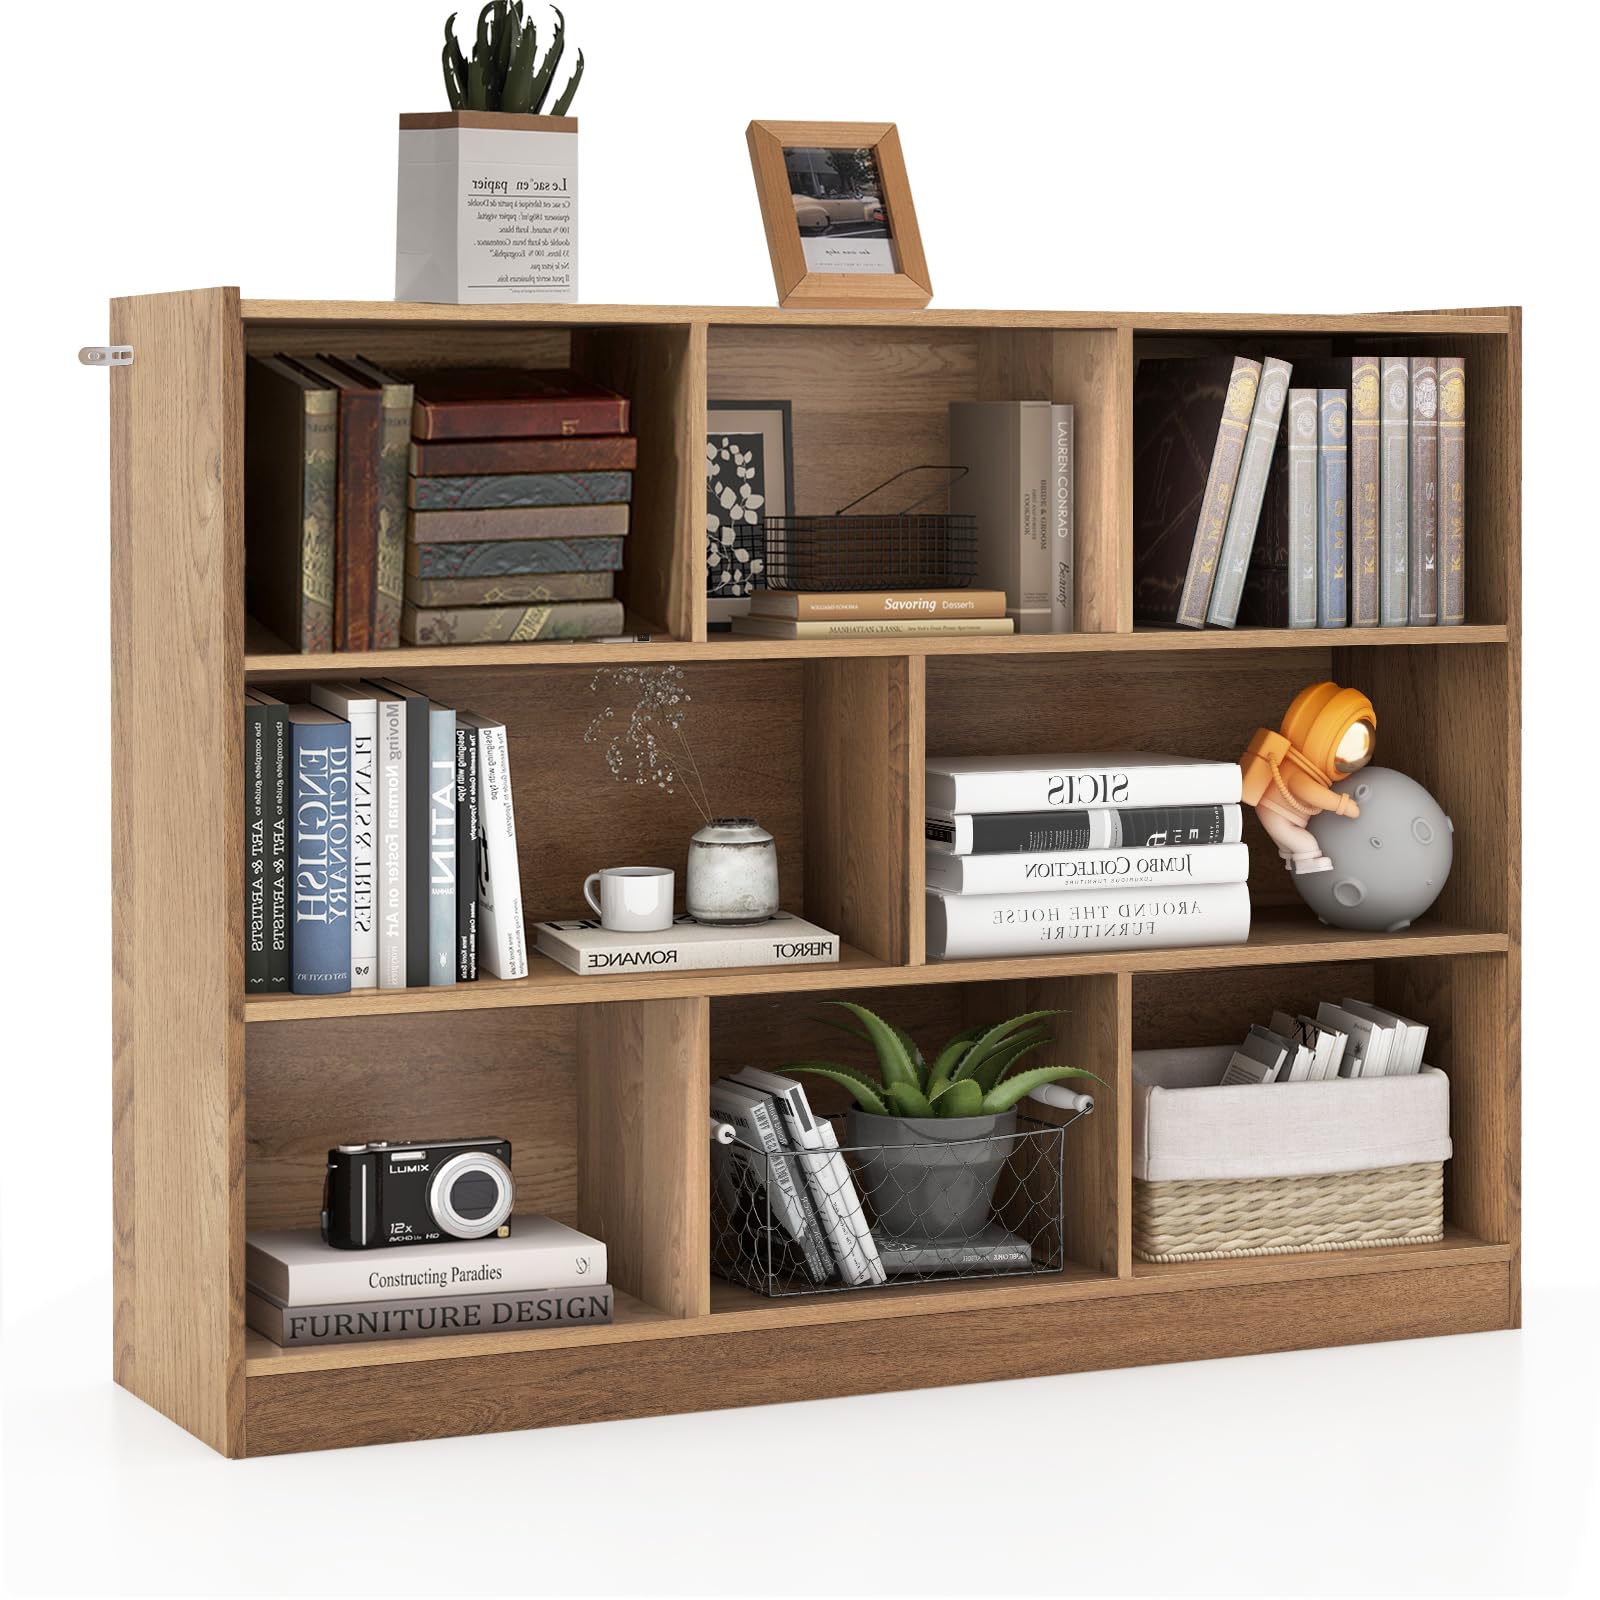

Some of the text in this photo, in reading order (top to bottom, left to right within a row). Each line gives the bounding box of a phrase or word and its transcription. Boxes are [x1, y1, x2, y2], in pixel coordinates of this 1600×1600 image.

[1057, 421, 1069, 538] LAUREN CONRAD
[1056, 561, 1070, 608] Beauty
[884, 598, 975, 612] Savoring Desserts
[829, 625, 873, 634] MANHATTAN
[389, 1164, 429, 1174] LUMIX
[390, 1222, 412, 1234] 12x
[369, 1264, 502, 1288] Constructing Paradies
[289, 1295, 610, 1340] FURNITURE DESIGN
